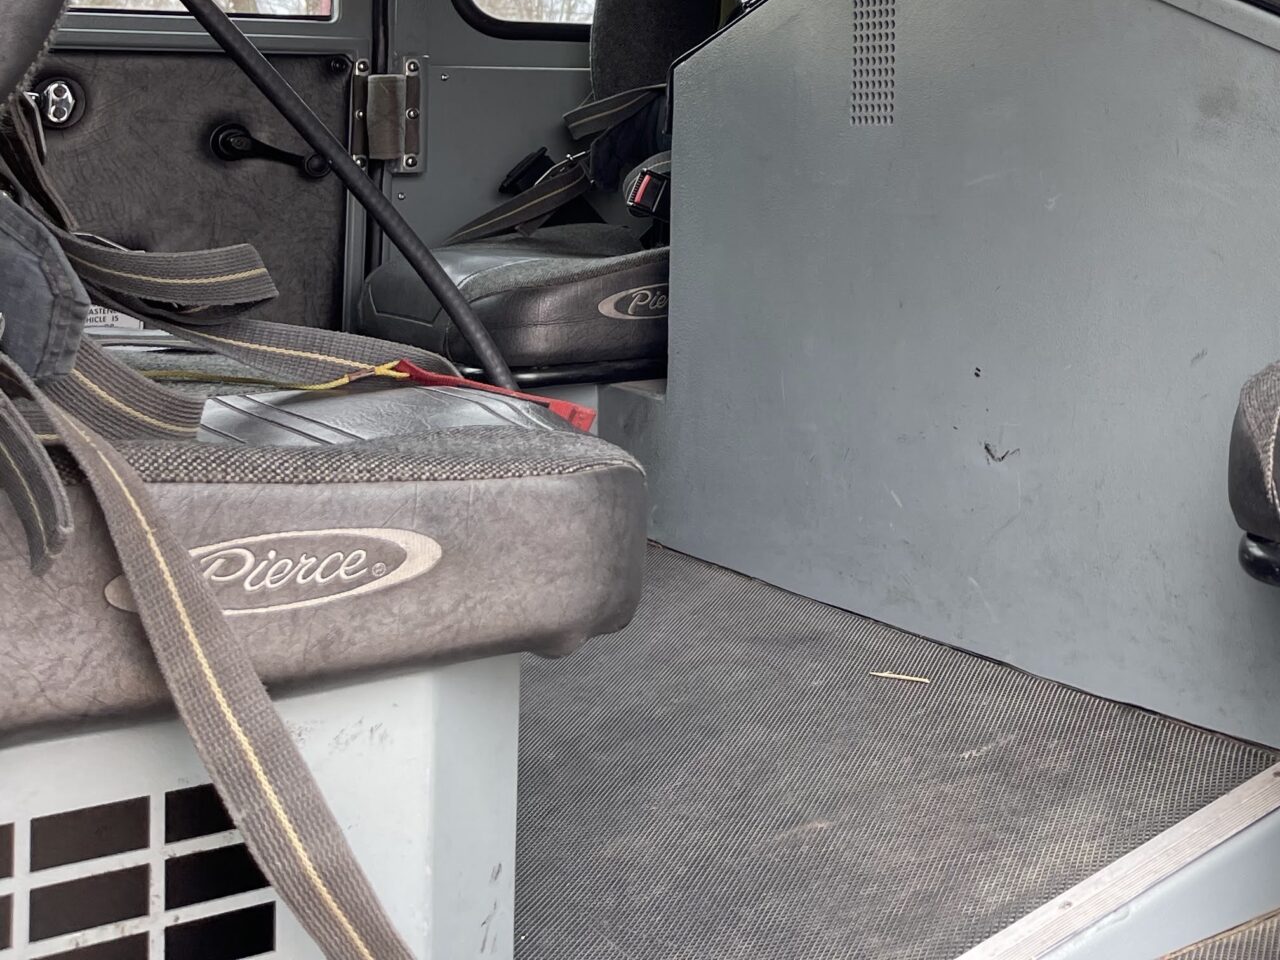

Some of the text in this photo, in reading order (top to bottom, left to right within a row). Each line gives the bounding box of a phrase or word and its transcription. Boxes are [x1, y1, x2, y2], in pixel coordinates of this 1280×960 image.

[628, 289, 668, 315] Pie
[86, 315, 106, 323] HICLE
[200, 548, 368, 592] Pierce
